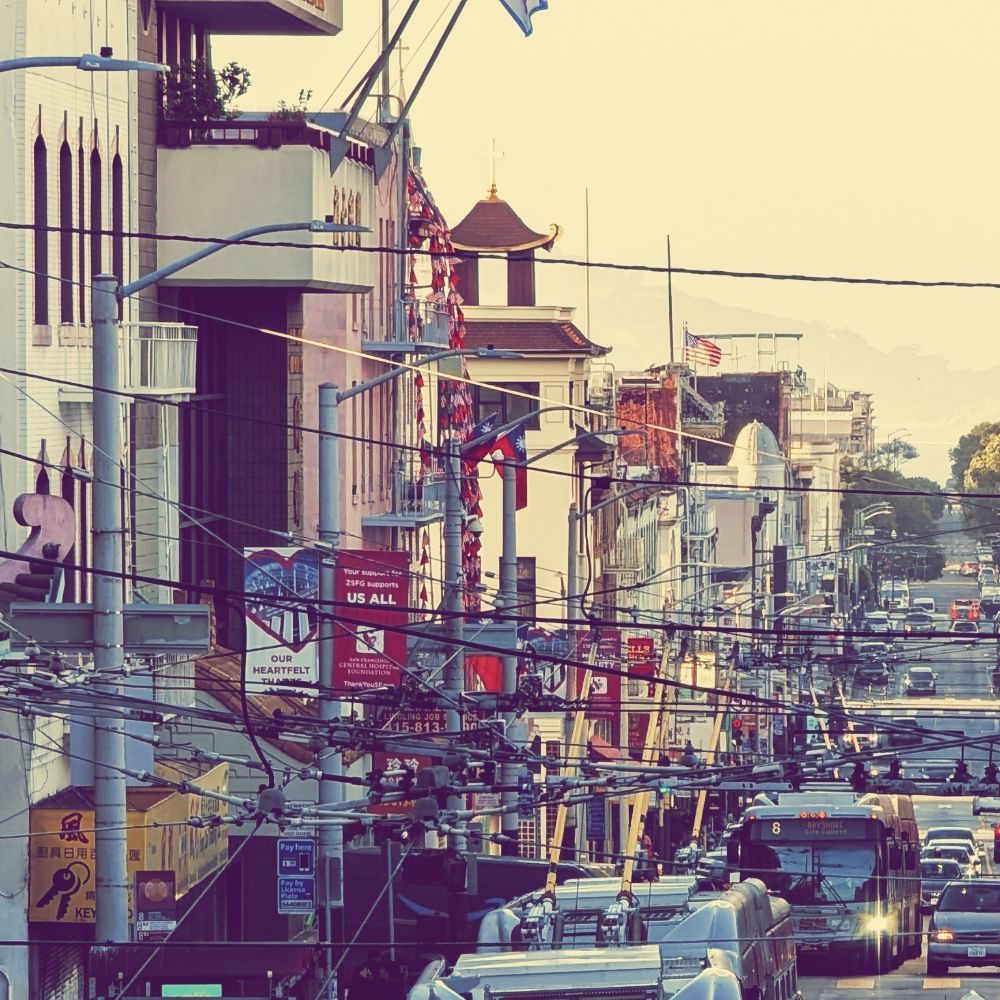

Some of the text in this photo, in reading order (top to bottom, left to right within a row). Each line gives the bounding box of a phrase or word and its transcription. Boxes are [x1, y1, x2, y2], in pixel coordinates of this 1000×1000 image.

[347, 593, 397, 605] US ALL
[270, 655, 293, 663] OUR
[252, 666, 311, 675] HEARTFELT
[771, 821, 781, 835] 8
[280, 843, 312, 852] Pay here
